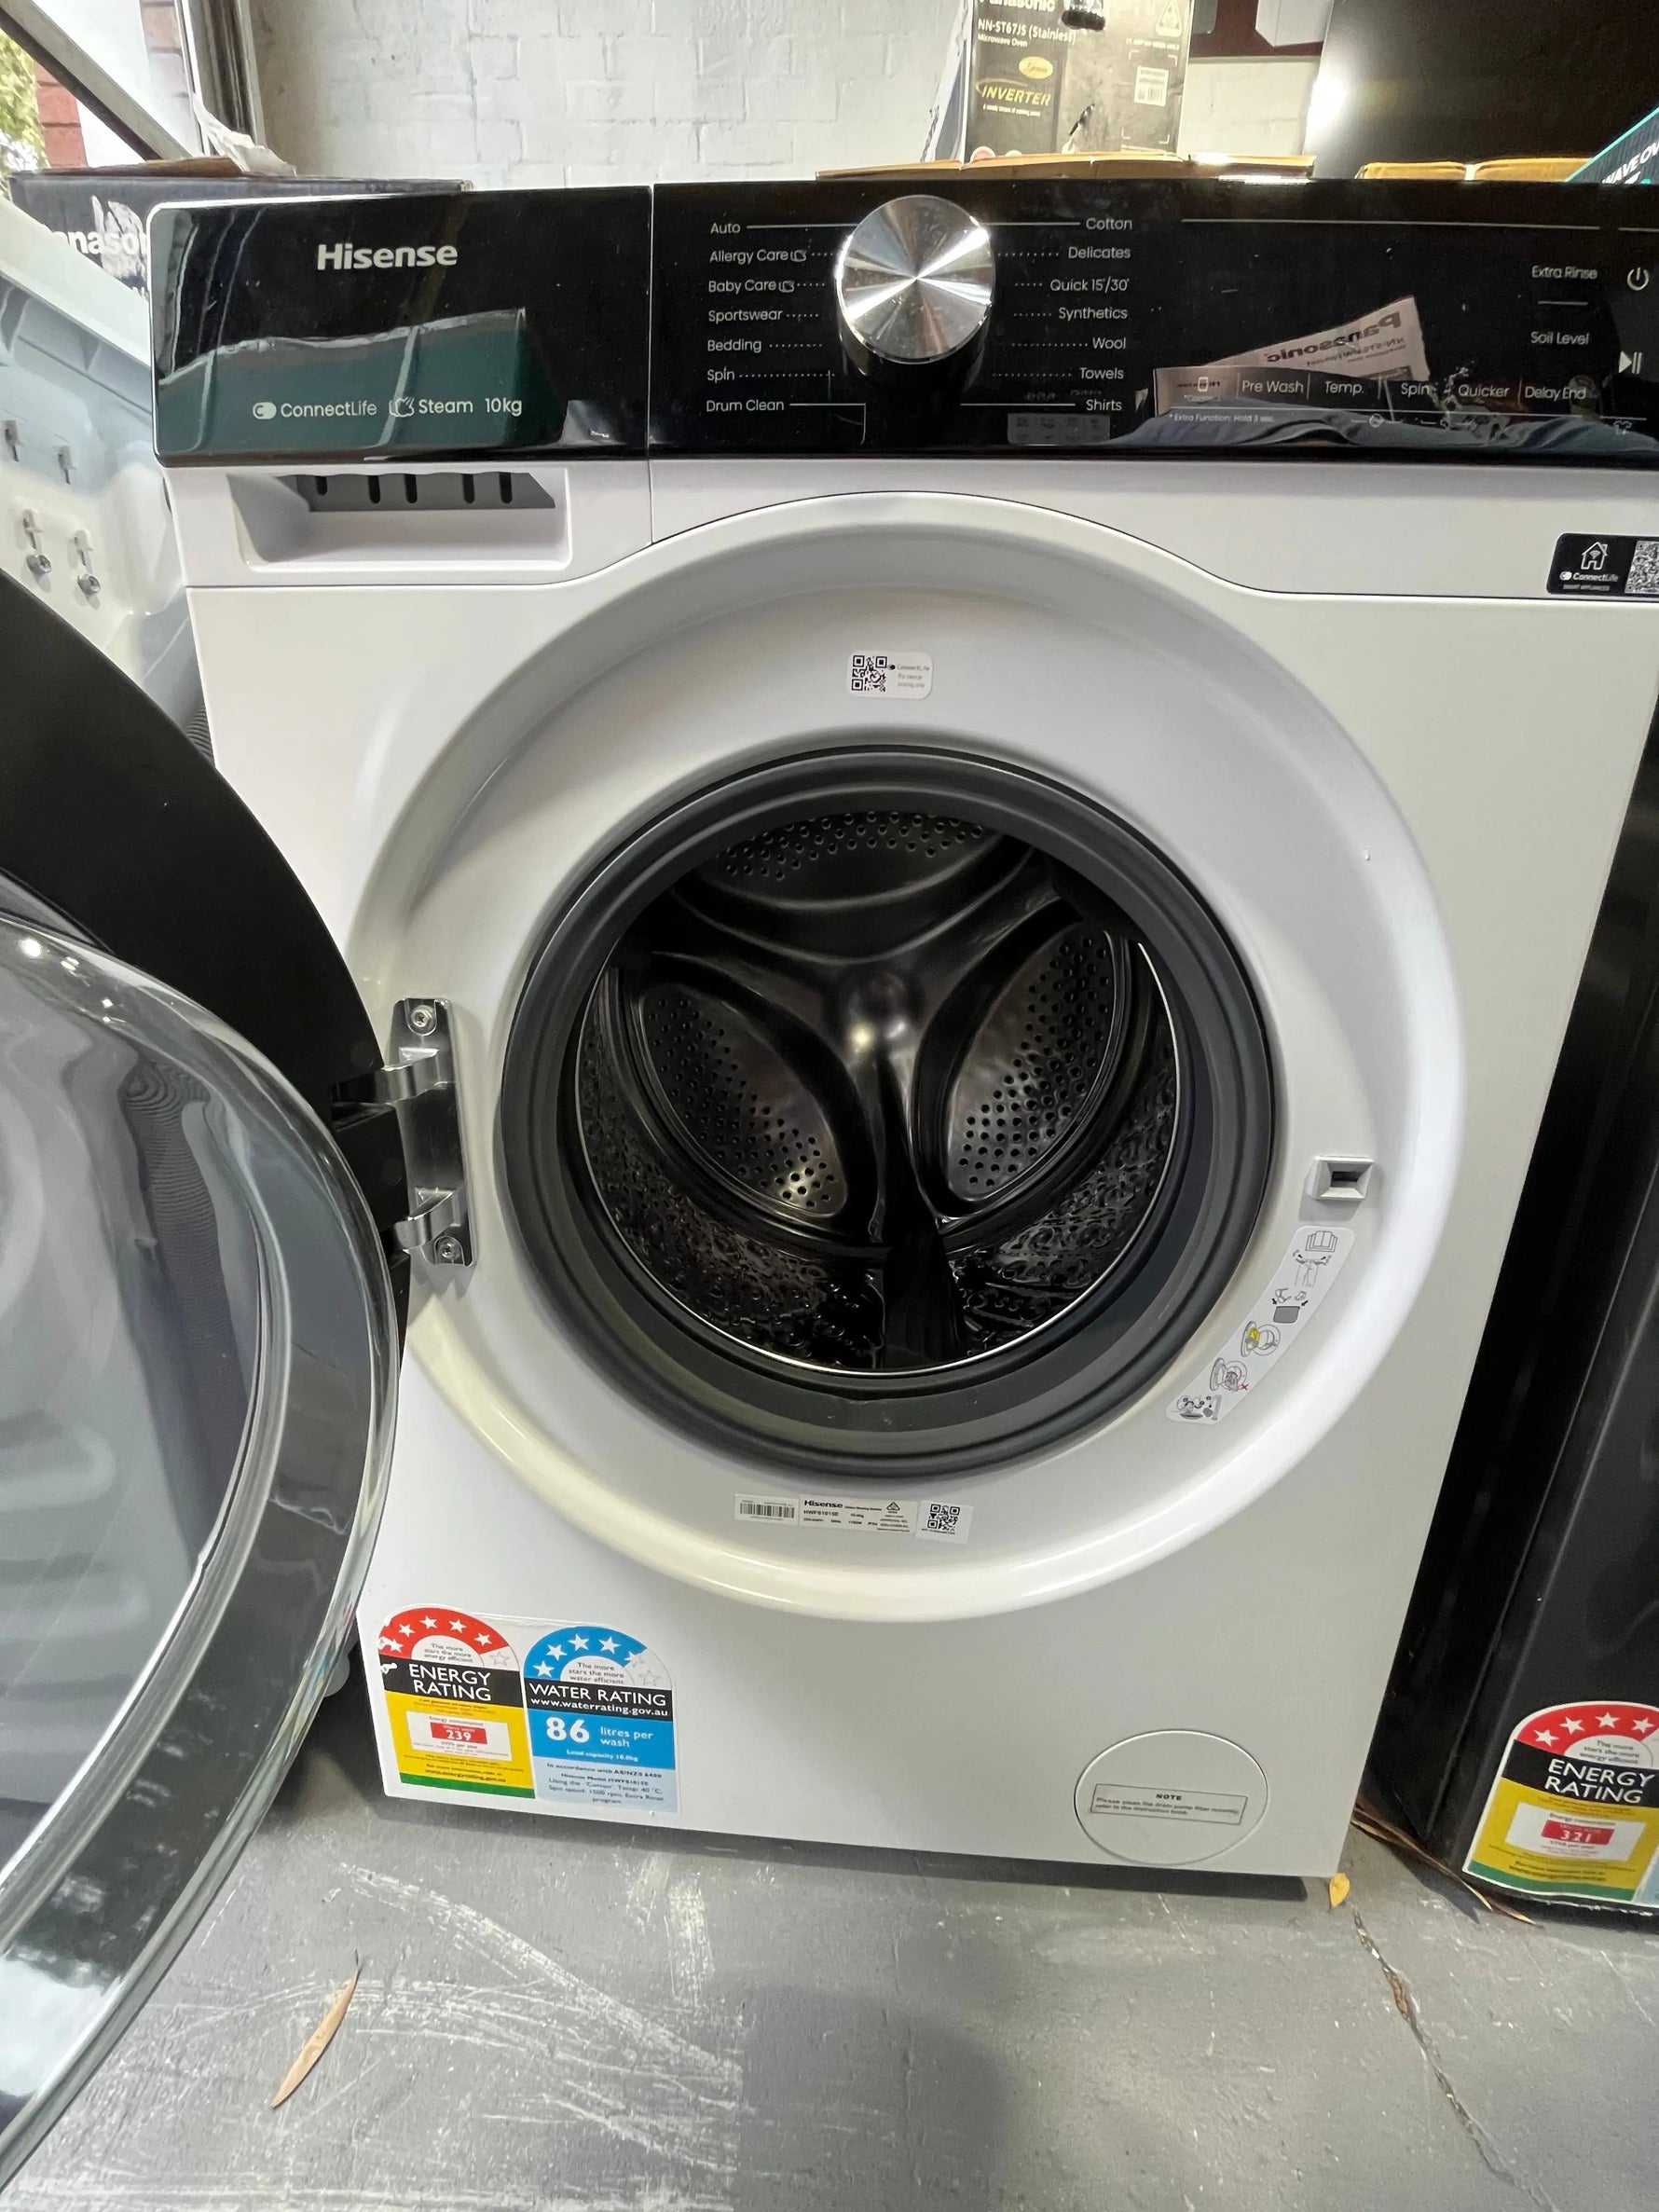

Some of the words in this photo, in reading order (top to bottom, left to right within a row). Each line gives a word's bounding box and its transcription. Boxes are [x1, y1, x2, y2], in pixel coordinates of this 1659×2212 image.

[981, 85, 1052, 106] INVERTER
[710, 222, 741, 234] Auto
[1086, 217, 1132, 230] Cotton
[317, 242, 459, 270] Hisense
[709, 250, 754, 265] Allergy
[756, 249, 788, 261] Care
[1068, 246, 1131, 259] Delicates
[1531, 265, 1562, 279] Extra
[1565, 266, 1597, 280] Rinse
[708, 280, 742, 295] Baby
[744, 279, 776, 292] Care
[1049, 279, 1089, 292] Quick
[708, 309, 783, 324] Sportswear
[1059, 307, 1129, 322] Synthetics
[707, 338, 761, 353] Bedding
[1092, 337, 1126, 350] Wool
[1530, 331, 1554, 344] Soil
[1556, 333, 1589, 345] Level
[707, 366, 734, 383] Spin
[1079, 367, 1124, 379] Towels
[1241, 380, 1264, 392] Pre
[1266, 380, 1304, 393] Wash
[1325, 381, 1364, 396] Temp.
[1400, 382, 1430, 396] Spin
[1458, 384, 1510, 397] Quicker
[1524, 386, 1562, 402] Delay
[1562, 387, 1586, 399] End
[281, 400, 377, 418] ConnectLife
[418, 398, 473, 414] Steam
[485, 397, 523, 417] 10kg
[706, 400, 743, 412] Drum
[746, 399, 785, 411] Clean
[1086, 399, 1123, 411] Shirts
[804, 1500, 843, 1508] Hisense
[408, 1663, 491, 1686] ENERGY
[413, 1679, 492, 1701] RATING
[528, 1683, 591, 1700] WATER
[597, 1689, 666, 1706] RATING
[530, 1697, 668, 1716] www.waterrating.gov.au
[446, 1730, 472, 1741] 239
[545, 1716, 590, 1743] 86
[600, 1726, 630, 1738] litres
[633, 1731, 653, 1740] per
[600, 1738, 630, 1748] wash
[1548, 1758, 1655, 1788] ENERGY
[1544, 1776, 1644, 1804] RATING
[1560, 1830, 1592, 1843] 321
